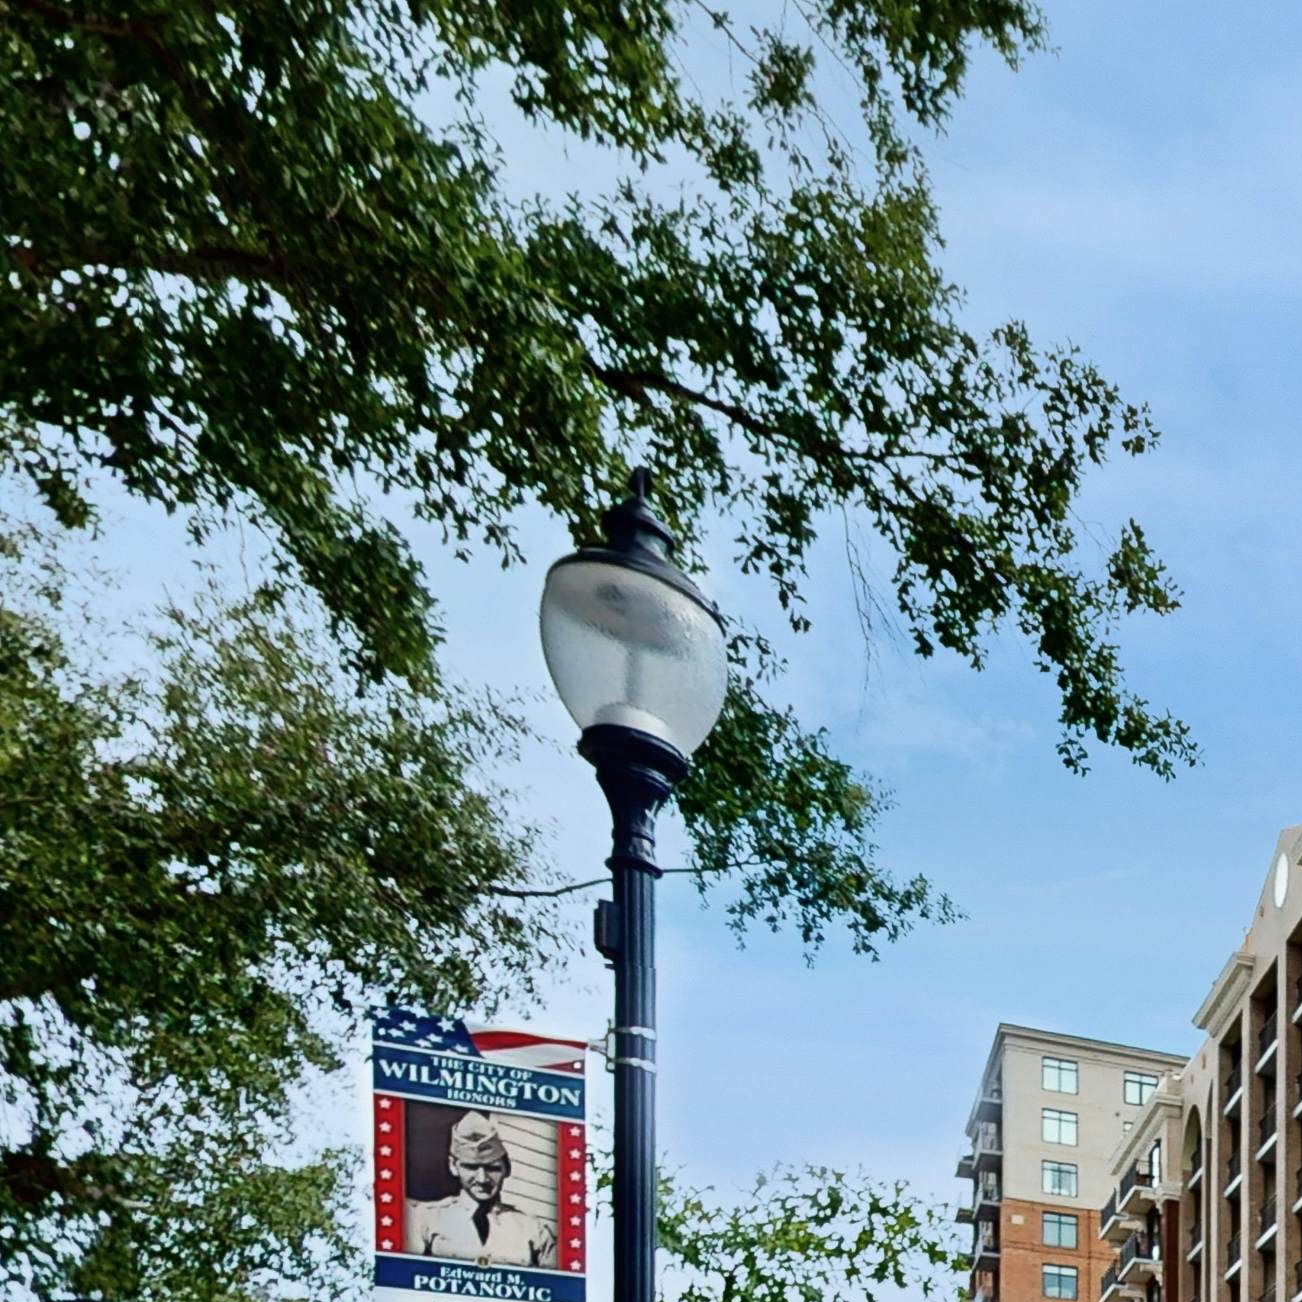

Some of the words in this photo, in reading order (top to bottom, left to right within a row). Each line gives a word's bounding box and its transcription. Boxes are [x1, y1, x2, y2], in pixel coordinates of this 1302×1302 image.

[430, 1056, 464, 1070] THE
[468, 1062, 506, 1076] CITY
[509, 1069, 533, 1080] OF
[378, 1059, 581, 1107] WILMINGTON
[447, 1088, 517, 1108] HONORS
[413, 1274, 552, 1302] POTANOVIC
[440, 1266, 502, 1285] Edward
[506, 1273, 526, 1286] M.
